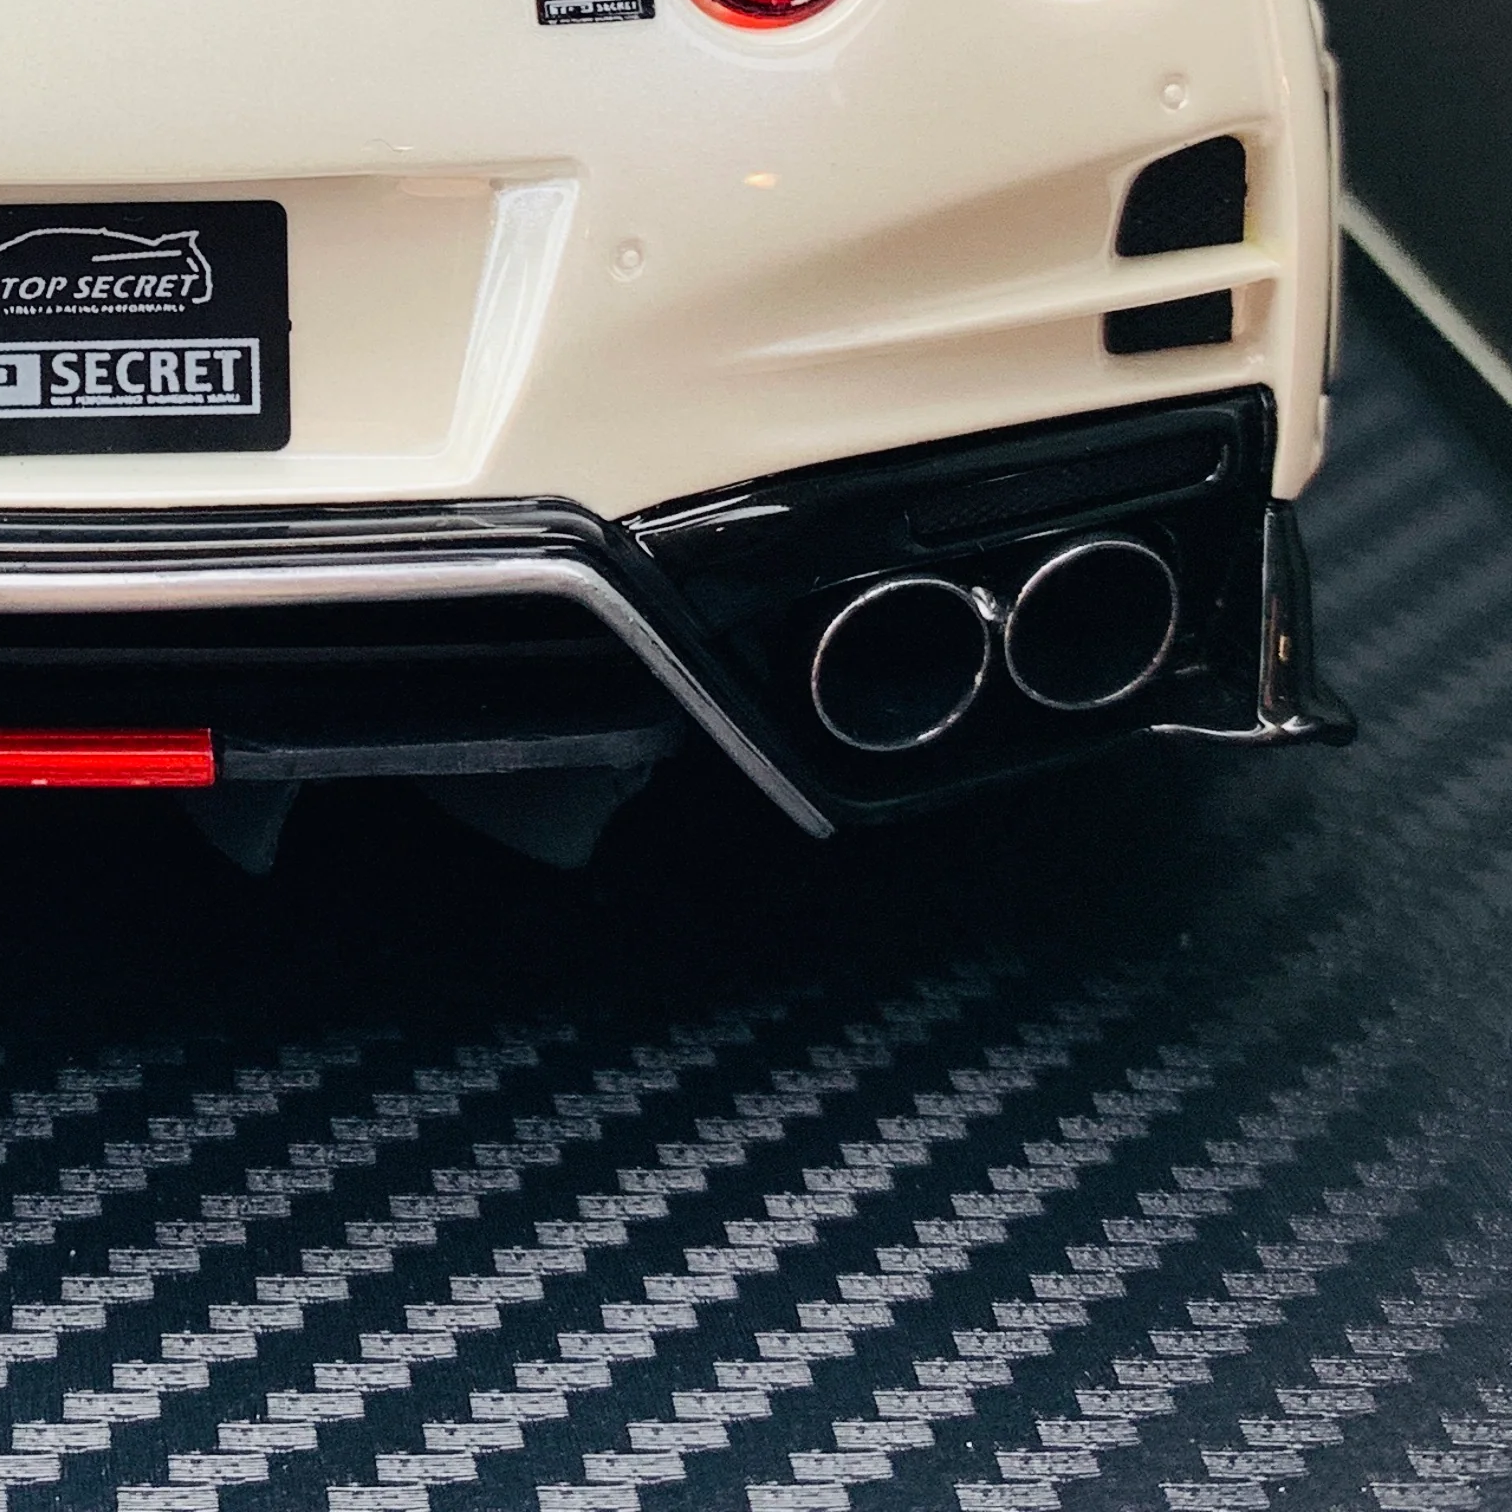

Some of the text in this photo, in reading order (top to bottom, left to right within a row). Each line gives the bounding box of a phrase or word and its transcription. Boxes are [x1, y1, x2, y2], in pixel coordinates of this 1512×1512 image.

[1, 272, 199, 300] TOP SECRET
[50, 350, 242, 395] SECRET
